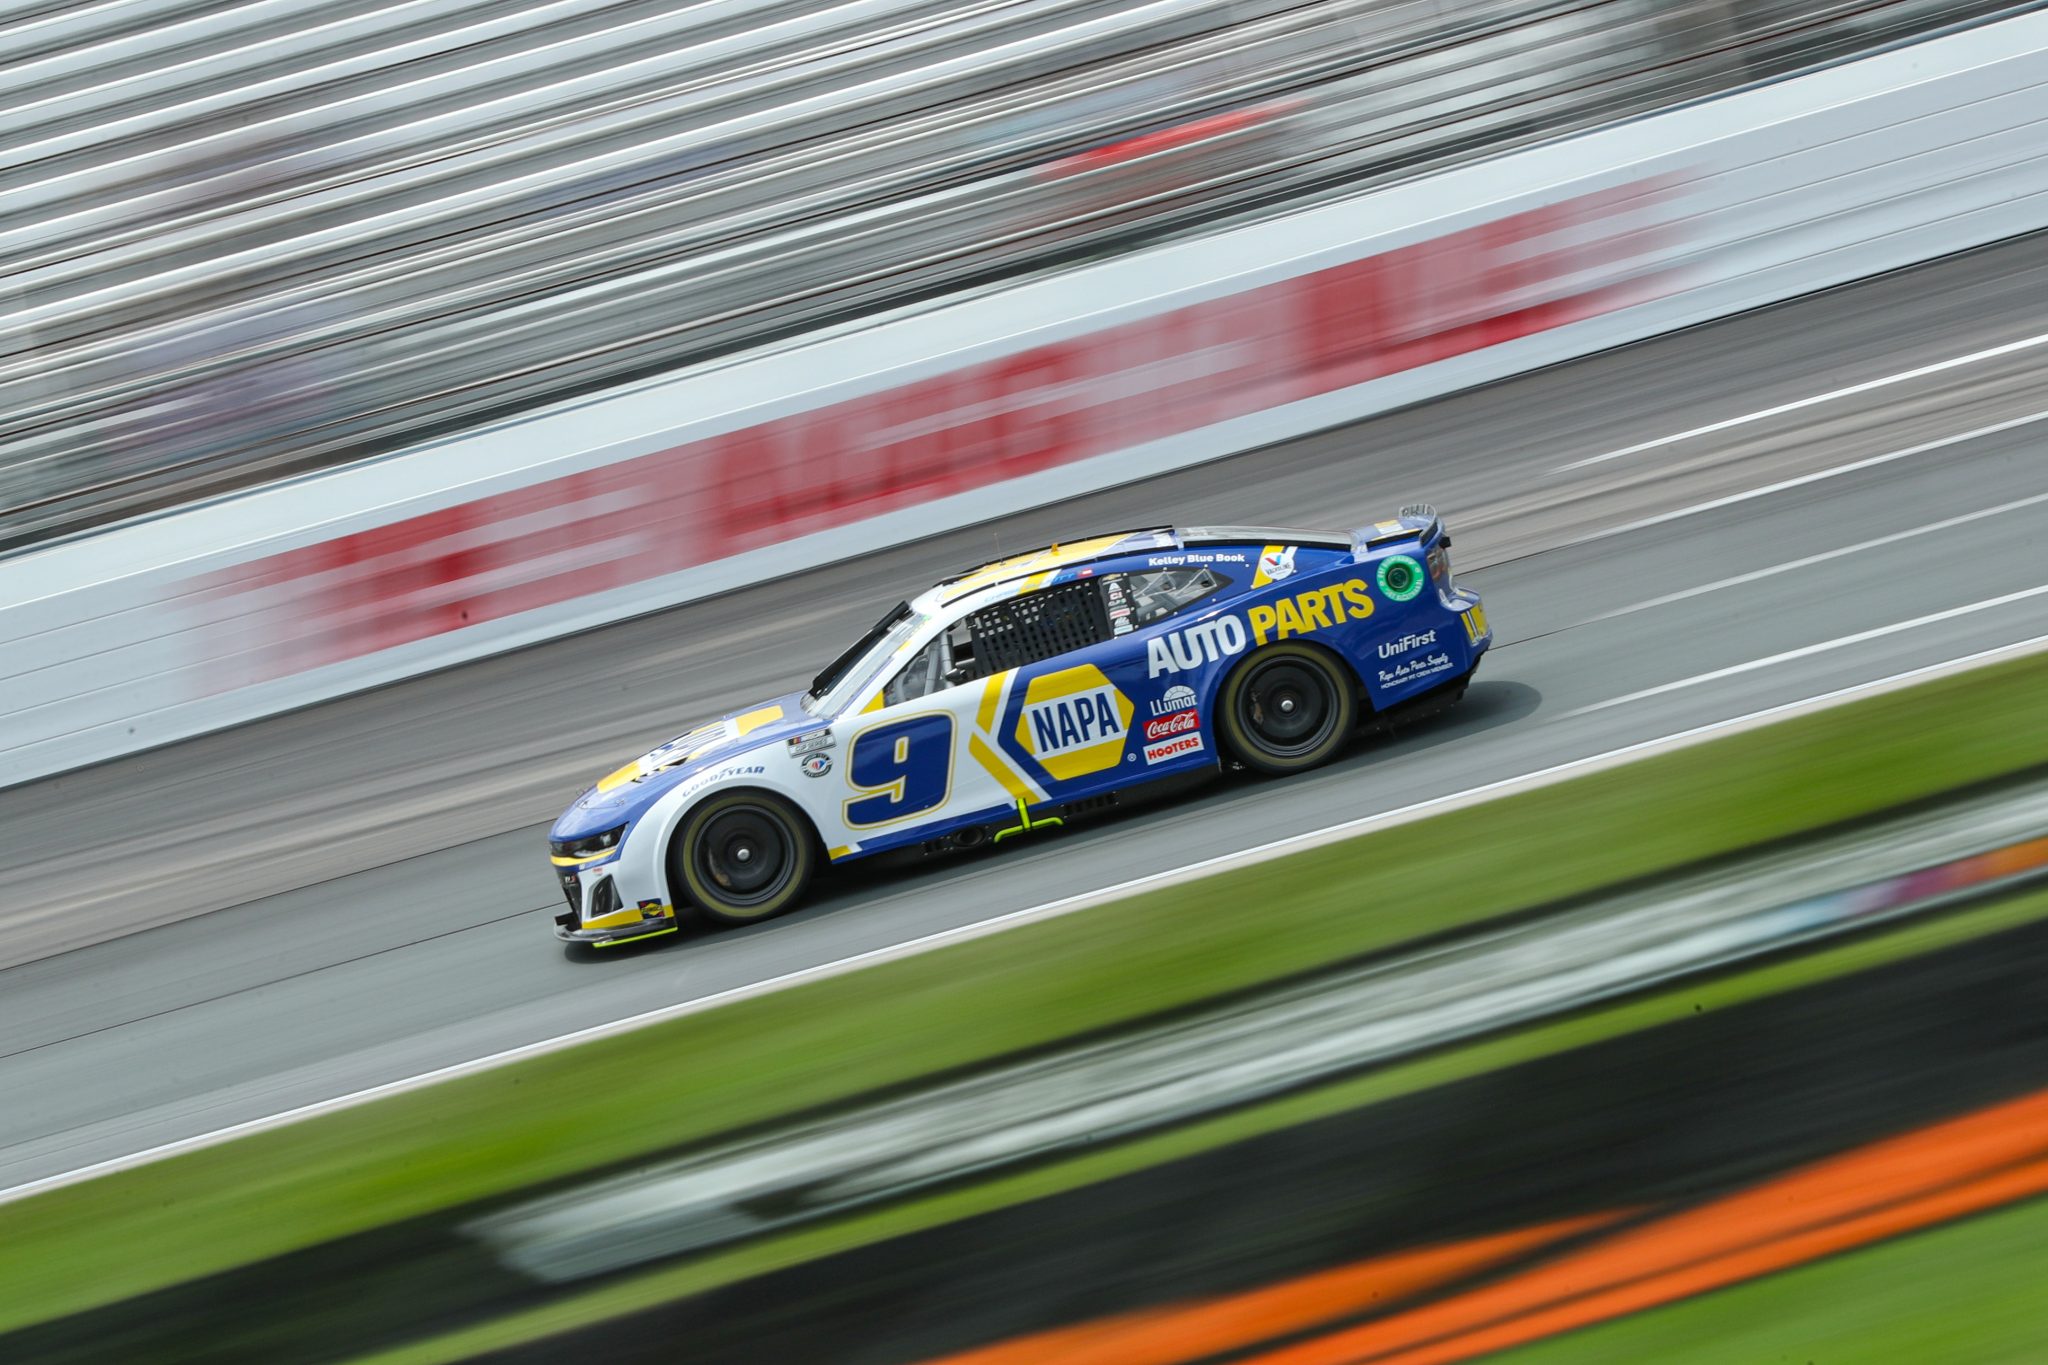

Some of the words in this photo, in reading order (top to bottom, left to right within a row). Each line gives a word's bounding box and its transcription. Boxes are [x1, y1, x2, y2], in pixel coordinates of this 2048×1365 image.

[1148, 554, 1186, 567] Kelley
[1187, 554, 1214, 564] Blue
[1216, 553, 1245, 562] Book
[1147, 615, 1246, 679] AUTO
[1248, 579, 1376, 647] PARTS
[1378, 630, 1437, 659] UniFirst
[1427, 653, 1449, 666] Supply
[1150, 694, 1197, 716] LLumar
[1032, 691, 1119, 752] NAPA
[1148, 737, 1199, 760] HOOTERS
[682, 766, 765, 798] GOODYEAR
[842, 709, 957, 831] 9
